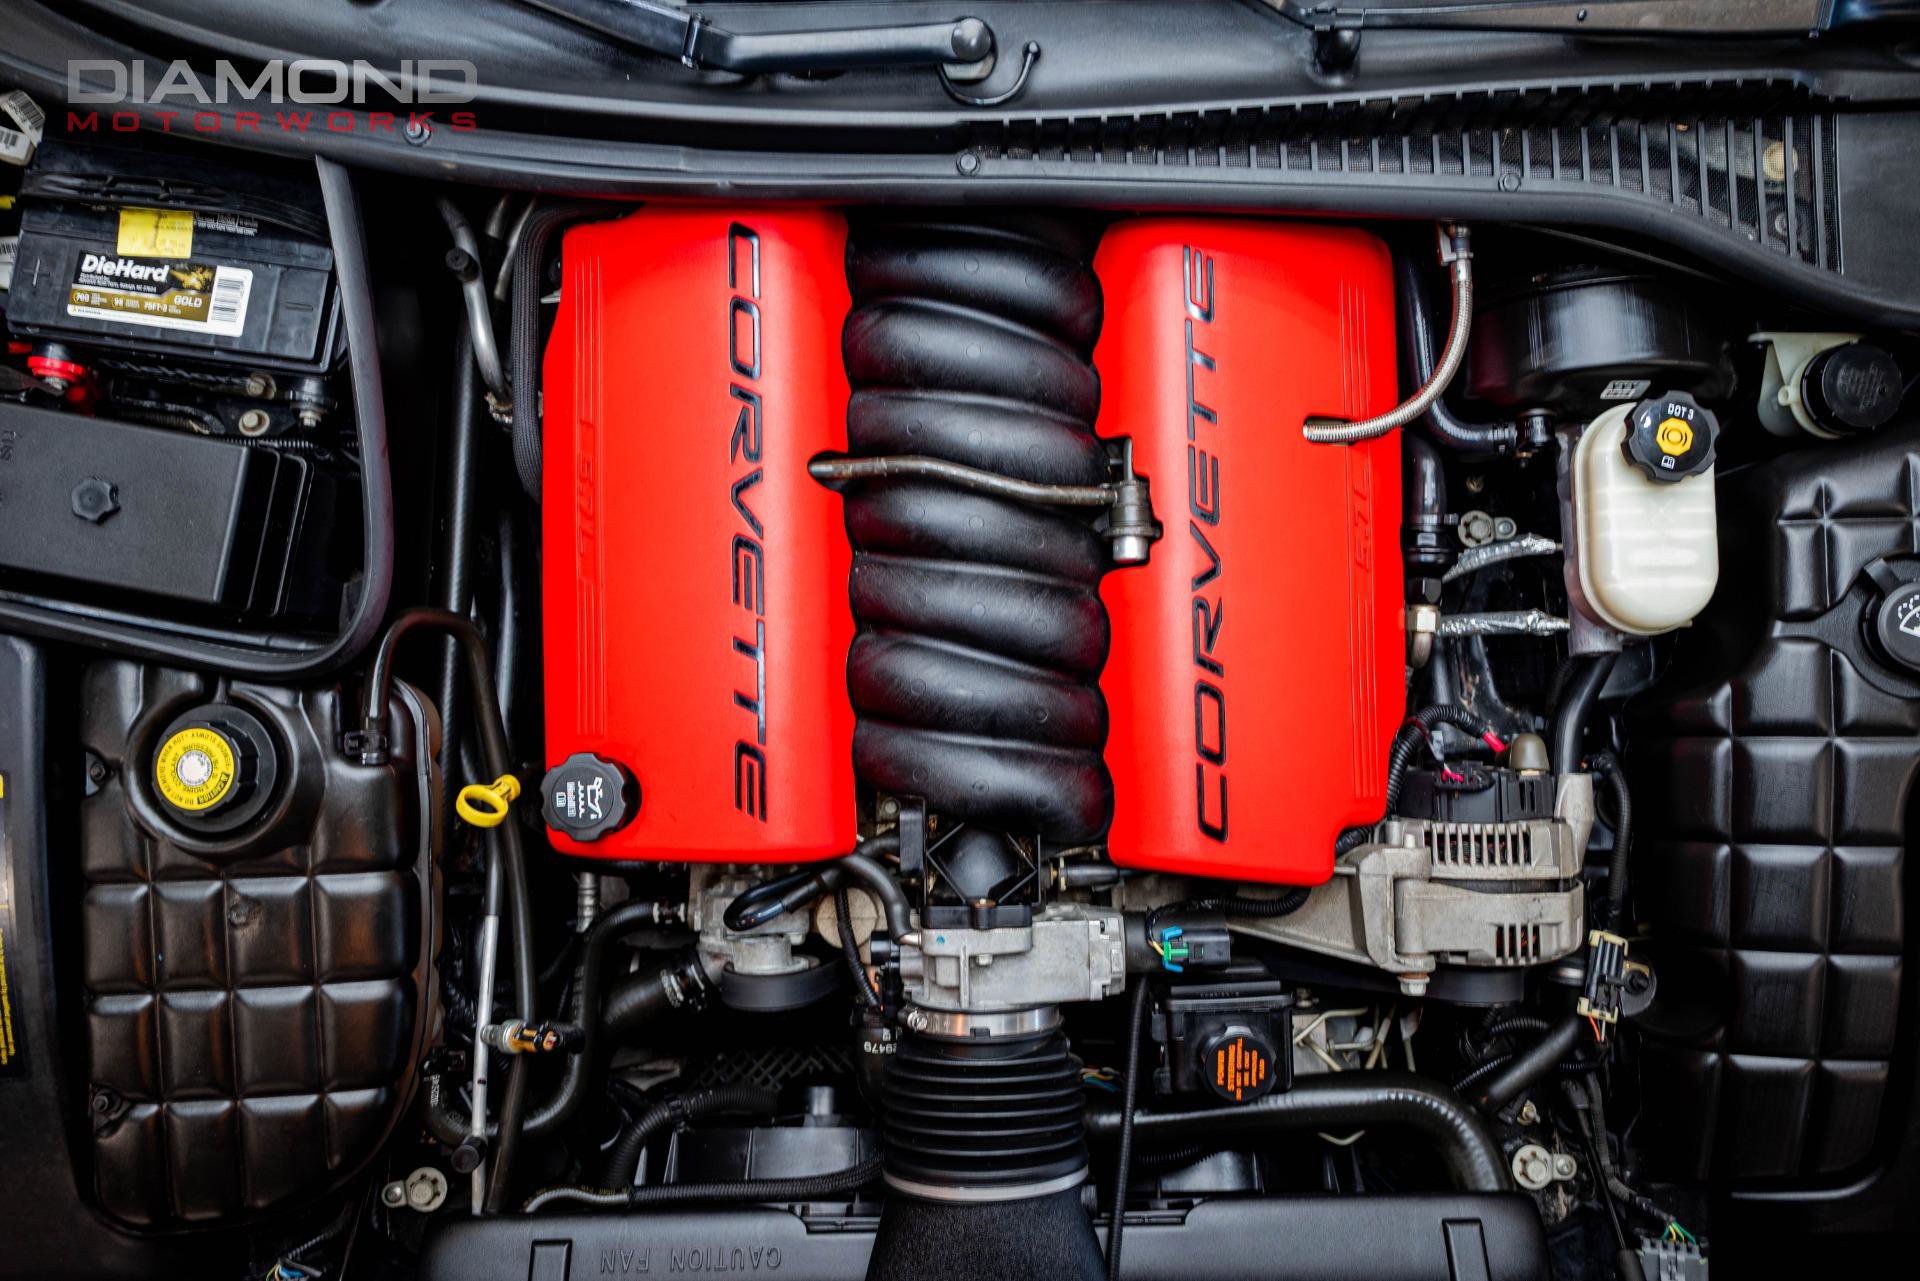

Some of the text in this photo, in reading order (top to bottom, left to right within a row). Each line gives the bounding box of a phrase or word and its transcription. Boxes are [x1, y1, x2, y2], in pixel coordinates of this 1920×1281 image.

[81, 253, 169, 283] DieHard
[174, 295, 202, 307] GOLD
[1668, 403, 1687, 418] DOT
[728, 220, 766, 823] CORVETTE
[1183, 245, 1228, 844] CORVETTE
[600, 1246, 782, 1274] CAUTION FAN
